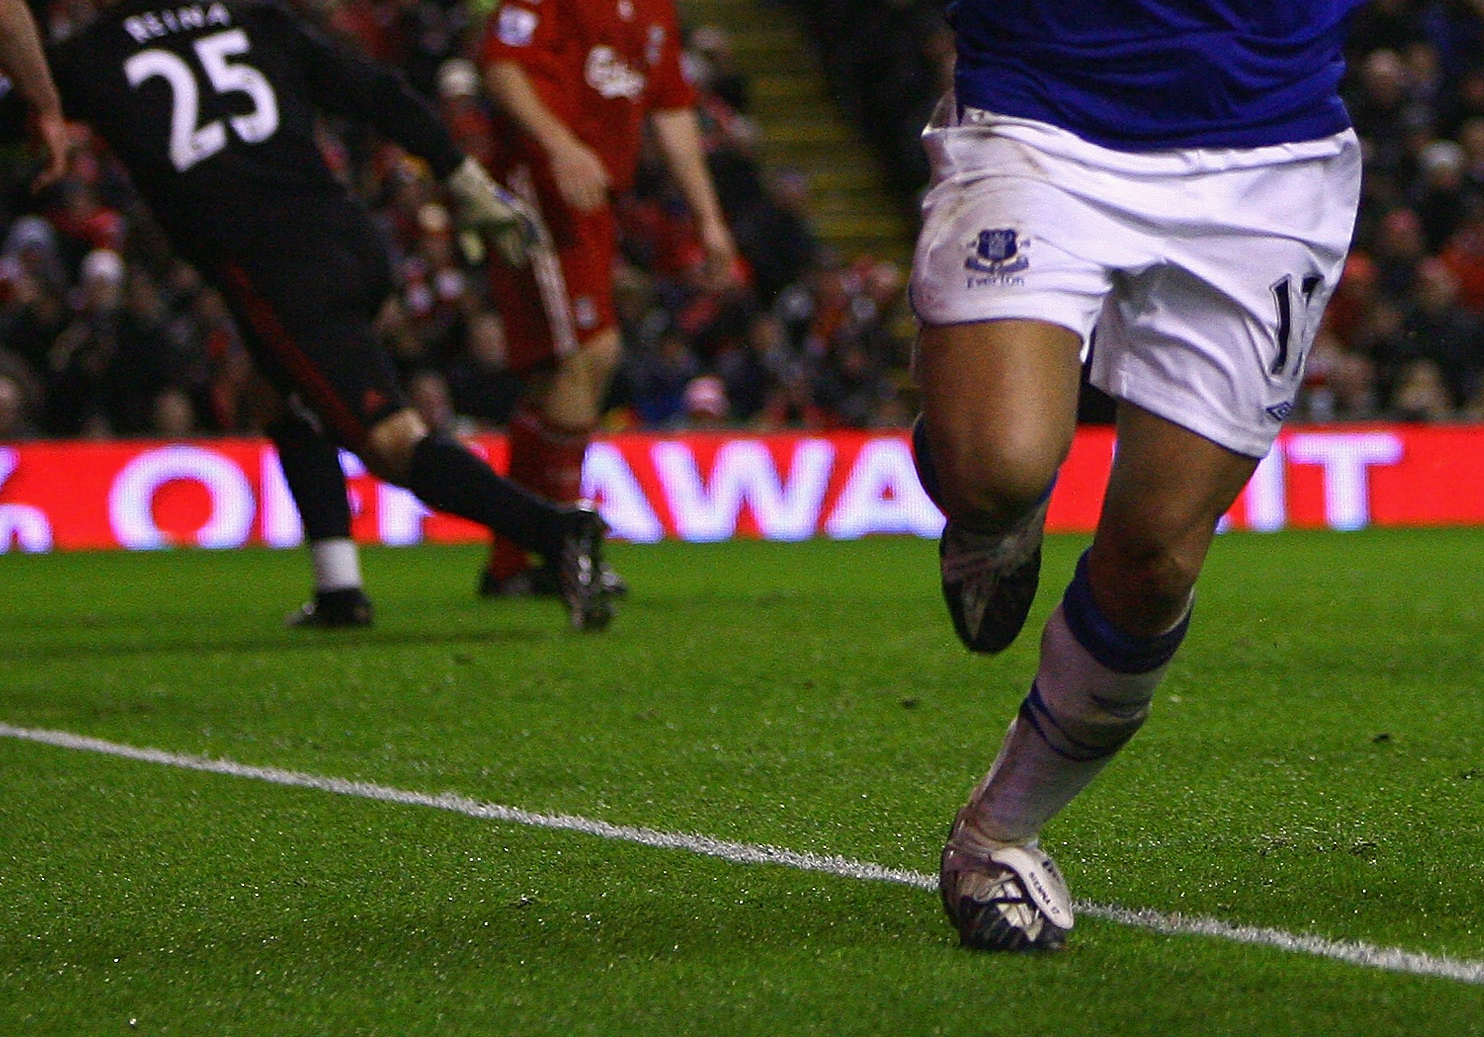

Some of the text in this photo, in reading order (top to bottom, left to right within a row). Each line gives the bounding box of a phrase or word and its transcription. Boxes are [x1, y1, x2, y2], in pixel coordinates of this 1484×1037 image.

[122, 2, 232, 44] REINA
[123, 28, 280, 173] 25
[581, 438, 948, 544] AWA
